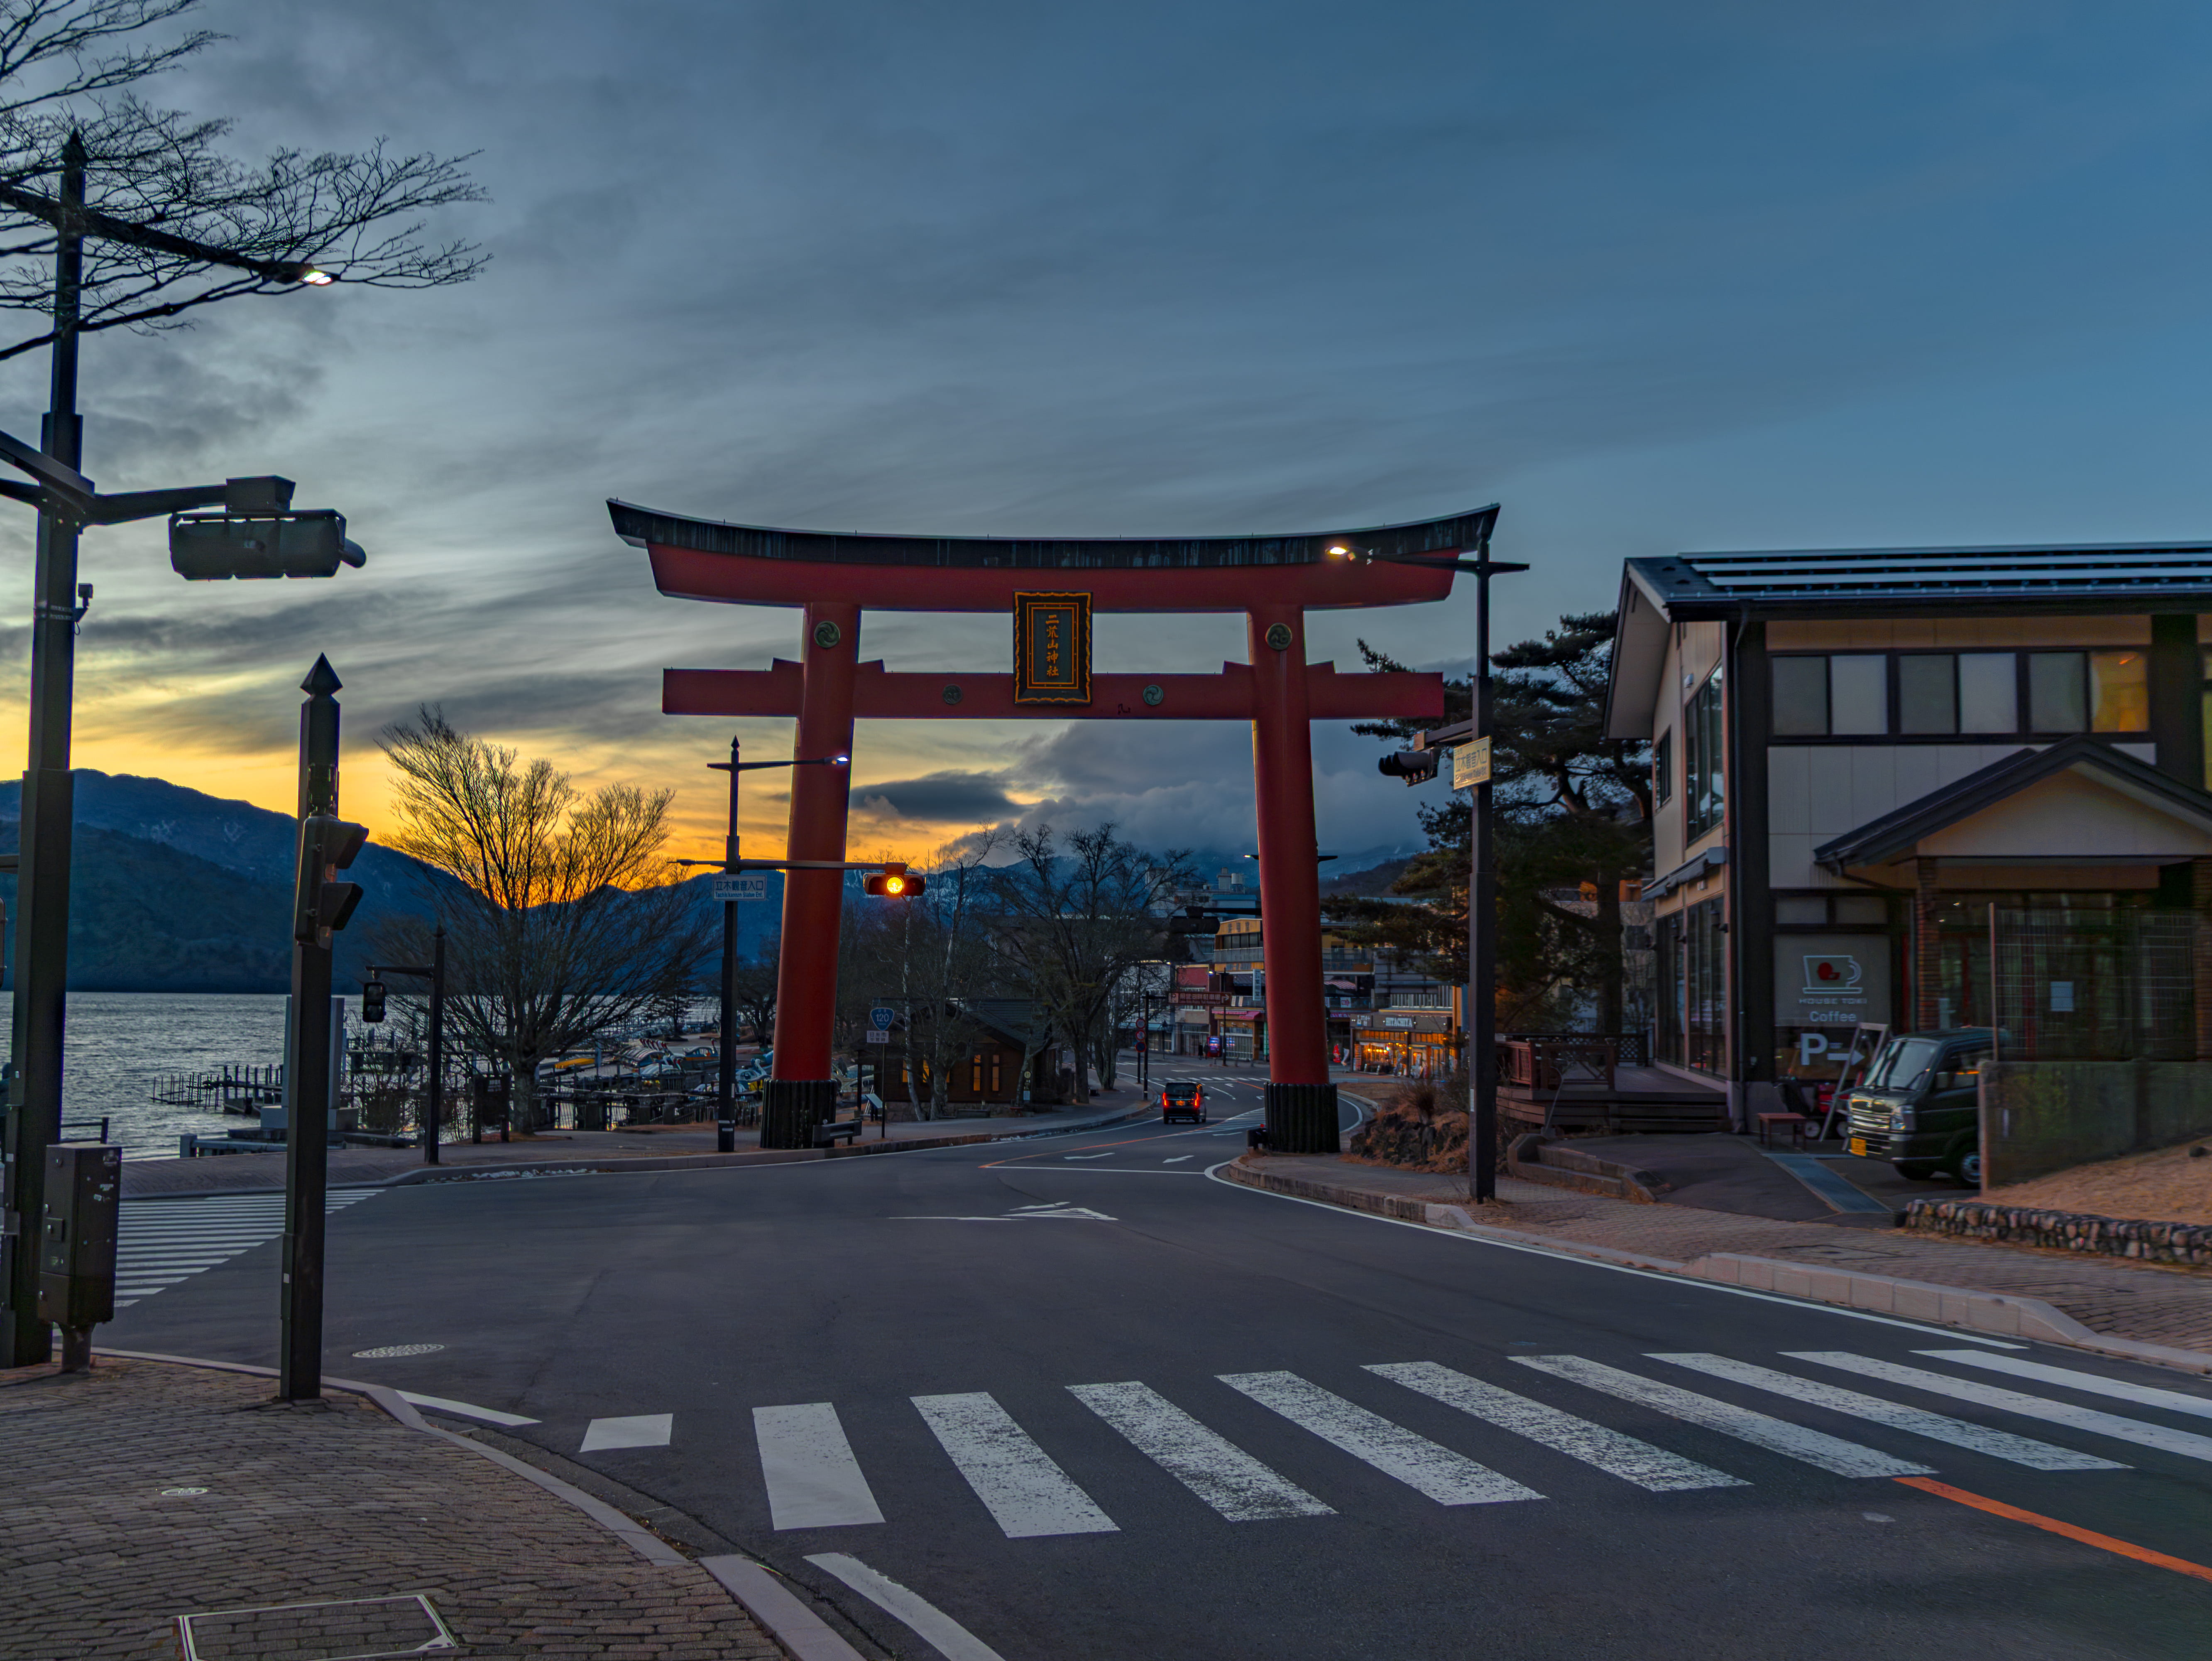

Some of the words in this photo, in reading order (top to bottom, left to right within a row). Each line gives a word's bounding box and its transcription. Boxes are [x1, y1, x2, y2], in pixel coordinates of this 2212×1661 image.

[1045, 615, 1059, 677] 二荒山神社
[876, 1013, 889, 1022] 120
[1385, 1017, 1412, 1027] HITACHIYA
[1809, 1011, 1857, 1022] Coffee
[1801, 1033, 1828, 1066] P
